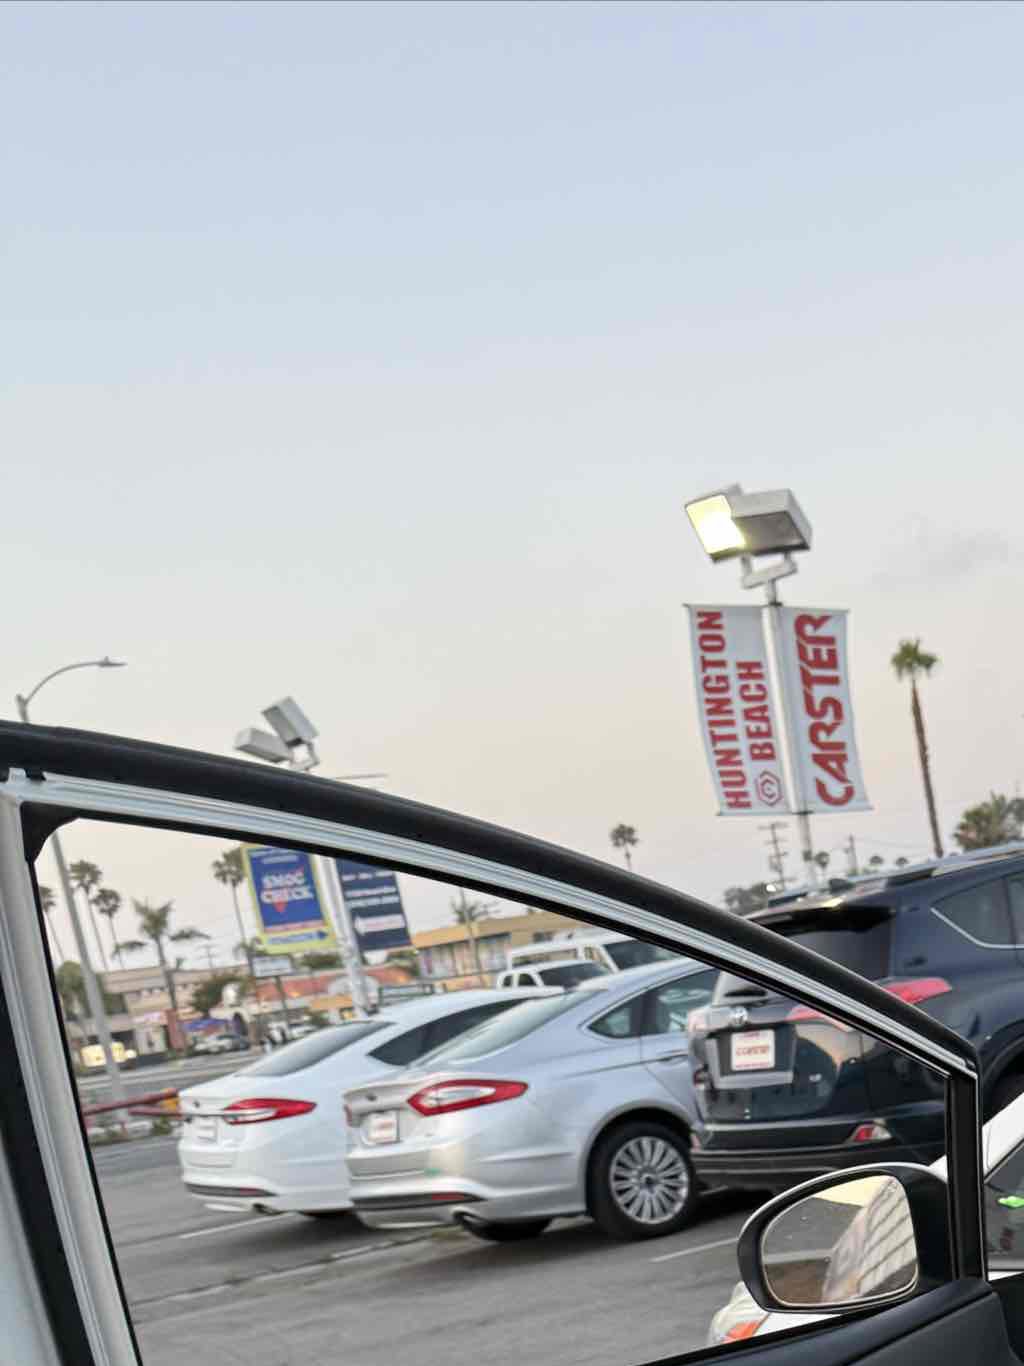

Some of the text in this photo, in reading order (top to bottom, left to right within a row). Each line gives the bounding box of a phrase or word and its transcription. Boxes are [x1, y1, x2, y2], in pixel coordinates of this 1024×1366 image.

[697, 610, 752, 809] HUNTINGTON
[736, 661, 777, 761] BEACH
[794, 613, 855, 806] CARSTER
